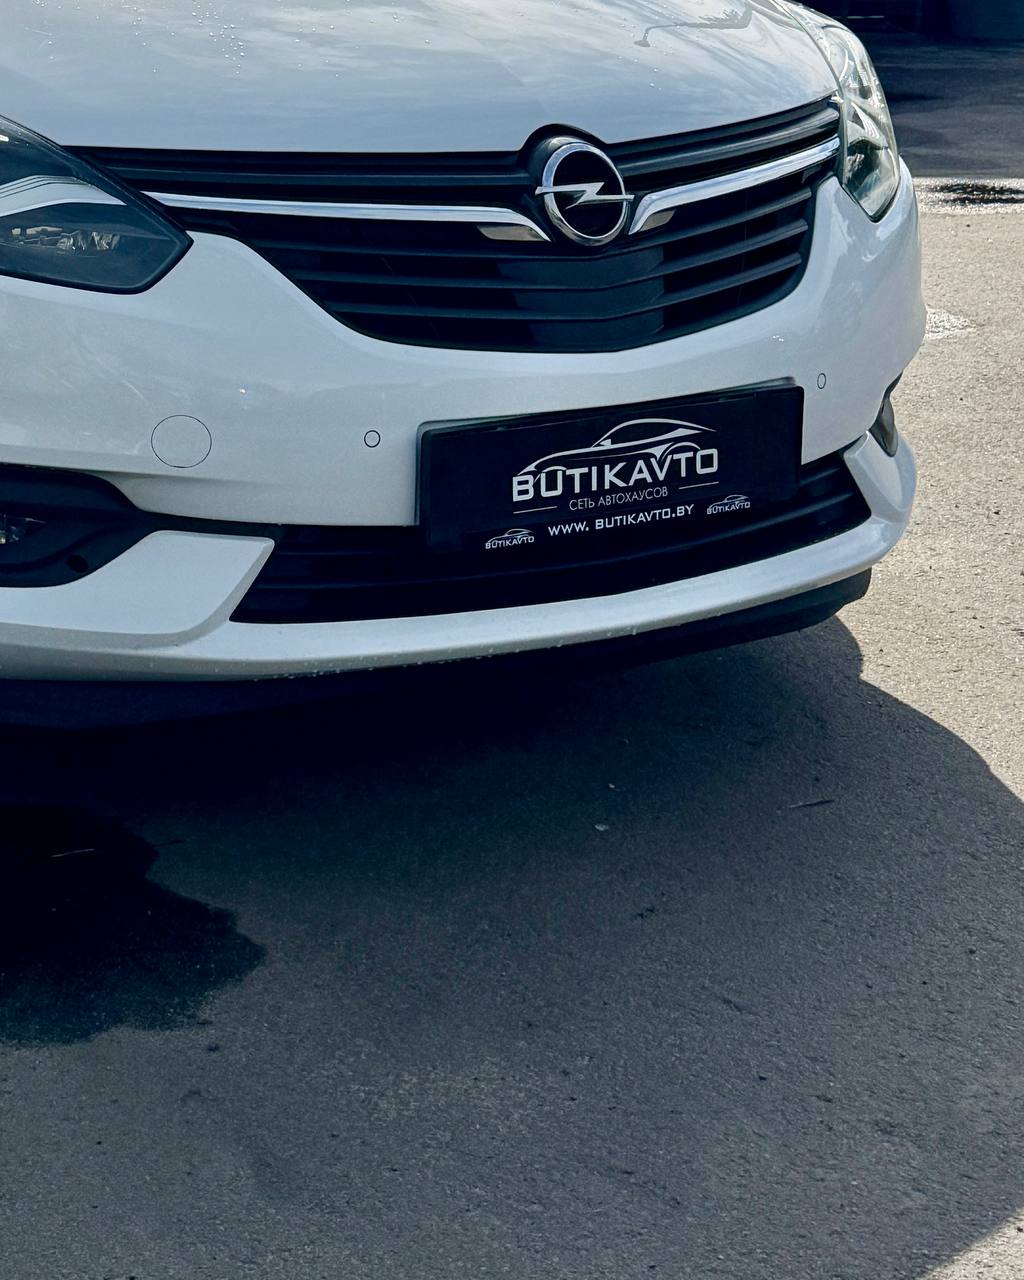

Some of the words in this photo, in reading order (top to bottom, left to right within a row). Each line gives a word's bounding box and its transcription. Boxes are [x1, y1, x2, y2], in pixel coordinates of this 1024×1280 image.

[512, 448, 719, 503] BUTIKAVTO
[569, 496, 595, 511] СЕТЬ
[597, 487, 669, 508] АВТОХАУСОВ
[706, 500, 751, 515] BUTIKAVTO
[547, 521, 590, 537] WWW.
[595, 504, 695, 530] BUTIKAVTO.BY
[485, 535, 535, 550] BUTIKAVTO
